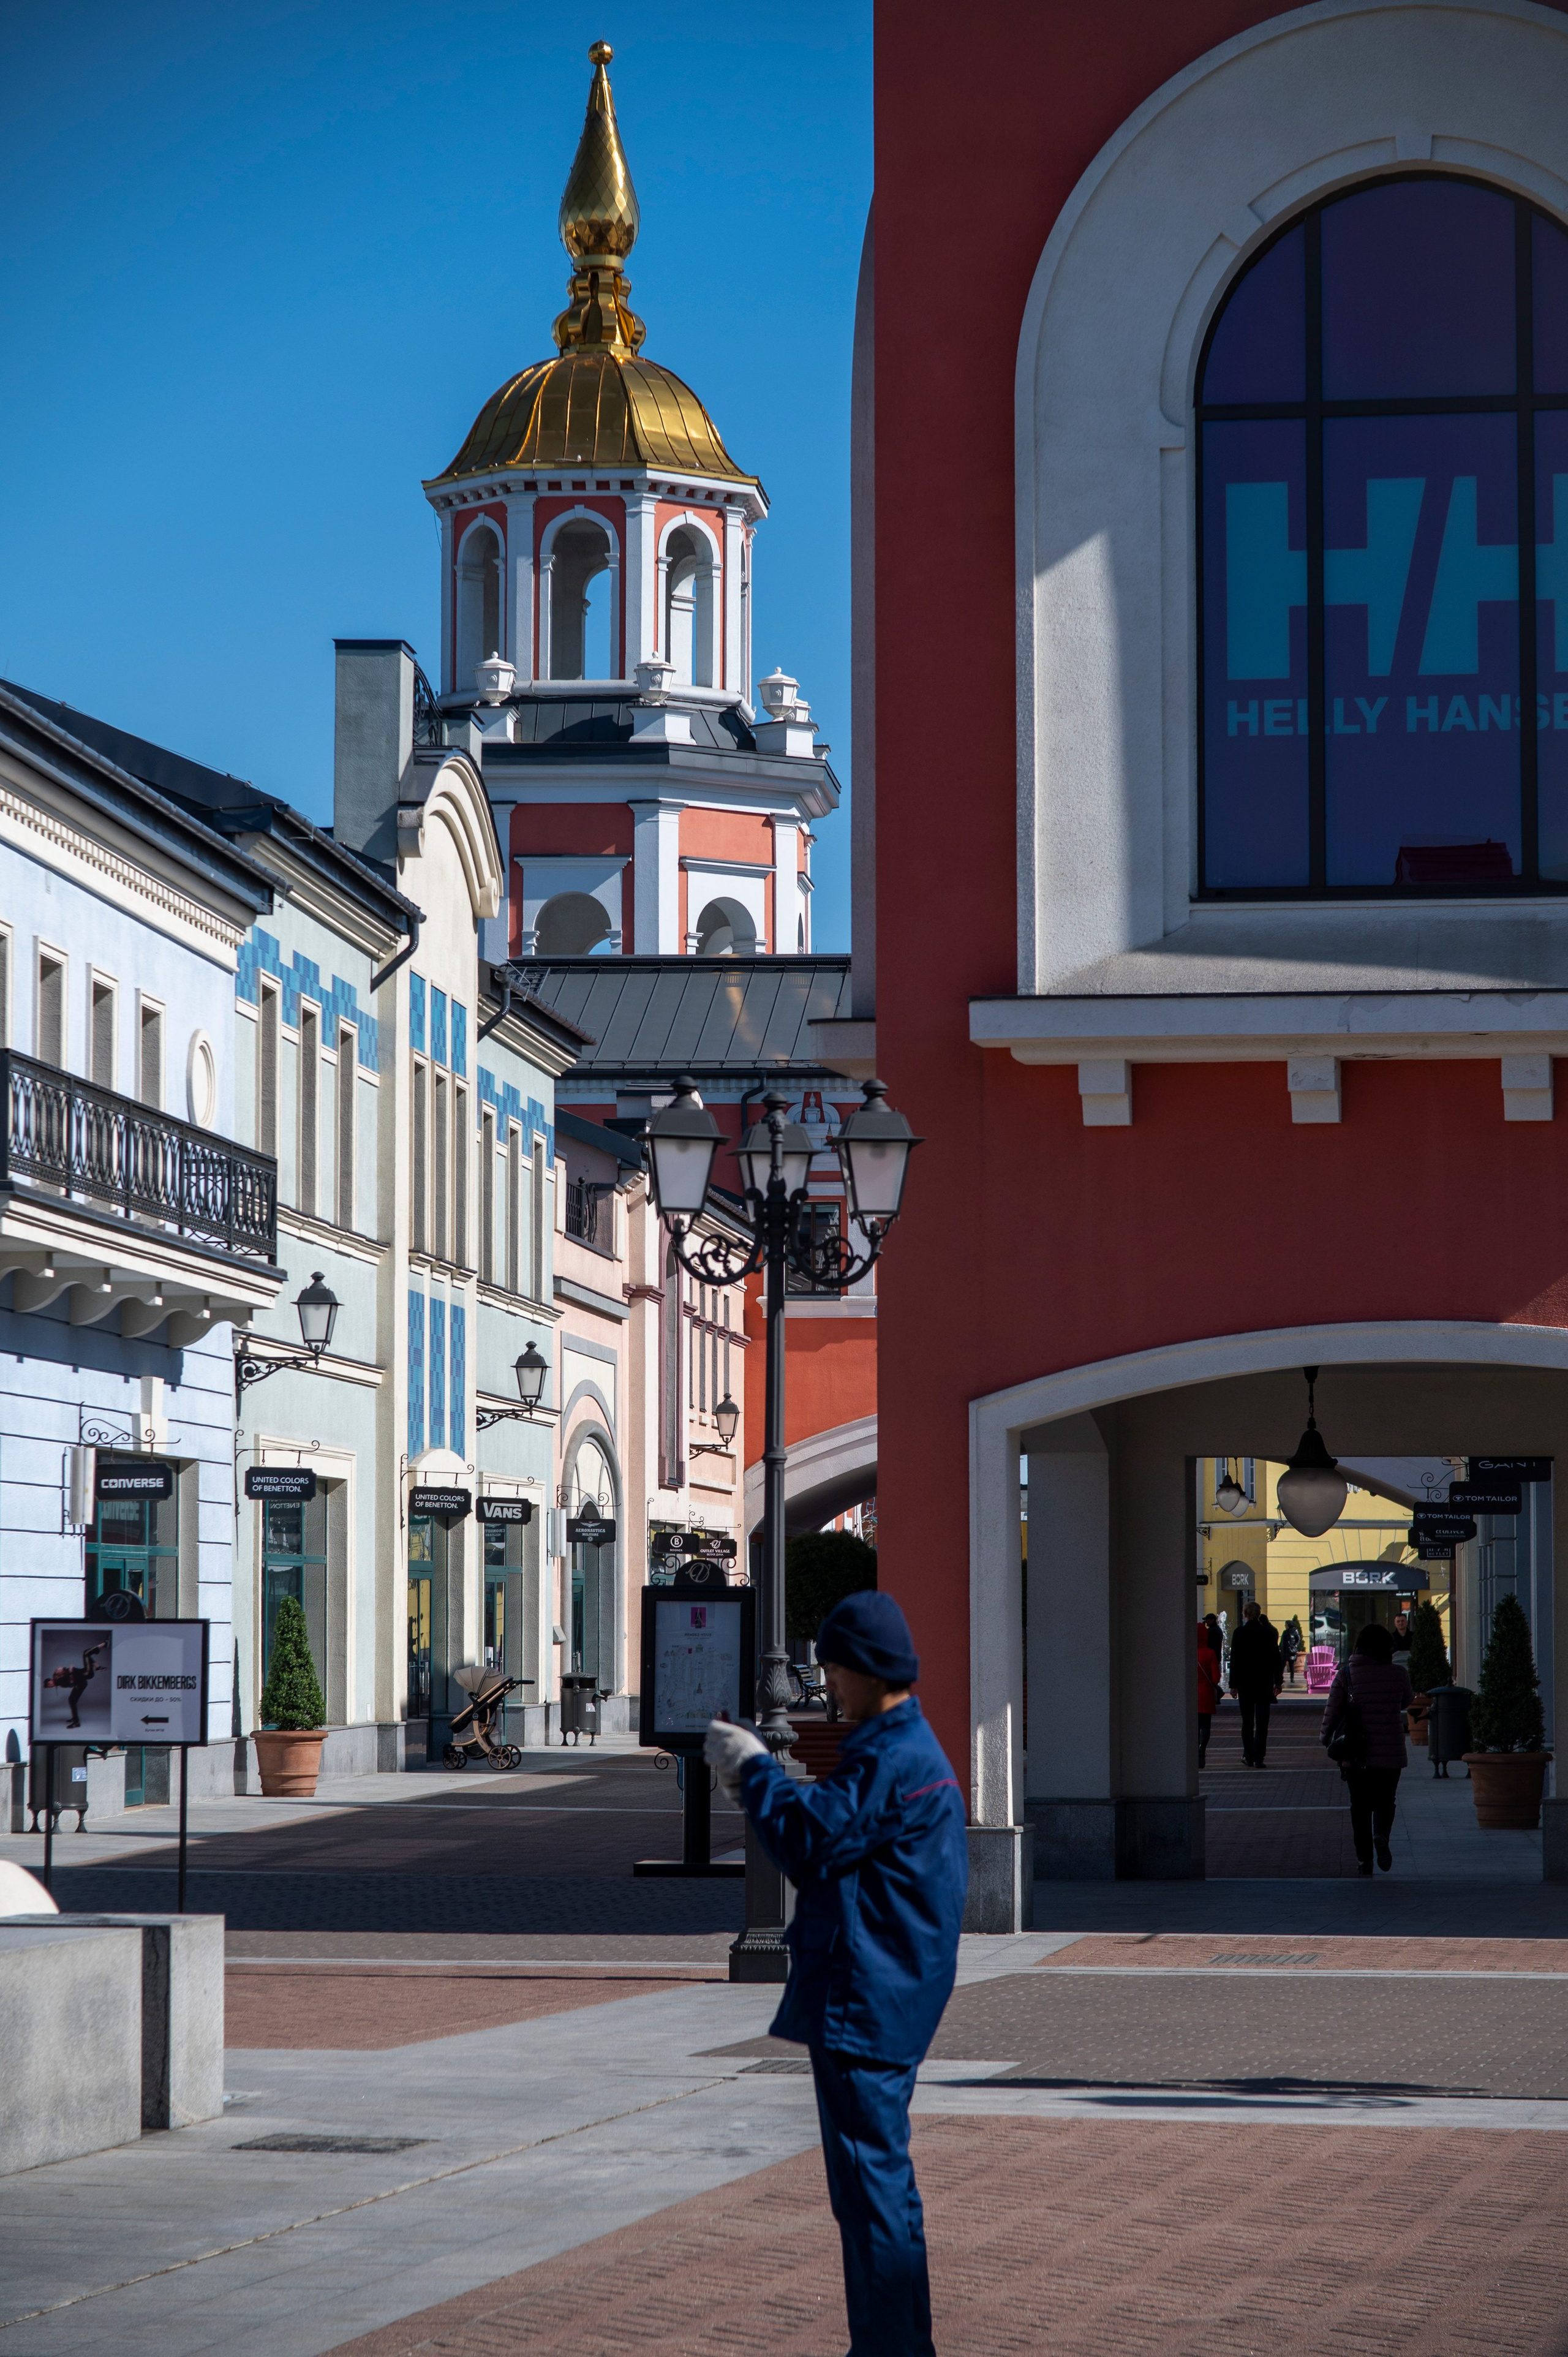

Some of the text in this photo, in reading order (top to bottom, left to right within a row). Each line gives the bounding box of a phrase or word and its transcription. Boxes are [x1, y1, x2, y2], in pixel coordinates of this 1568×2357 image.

[1227, 696, 1389, 737] HELLY
[100, 1477, 164, 1489] CONVERSE
[483, 1502, 522, 1519] VANS
[1232, 1574, 1249, 1585] BORK
[1343, 1572, 1396, 1584] BORK
[116, 1675, 197, 1689] DIRK BIKKEMBERGS
